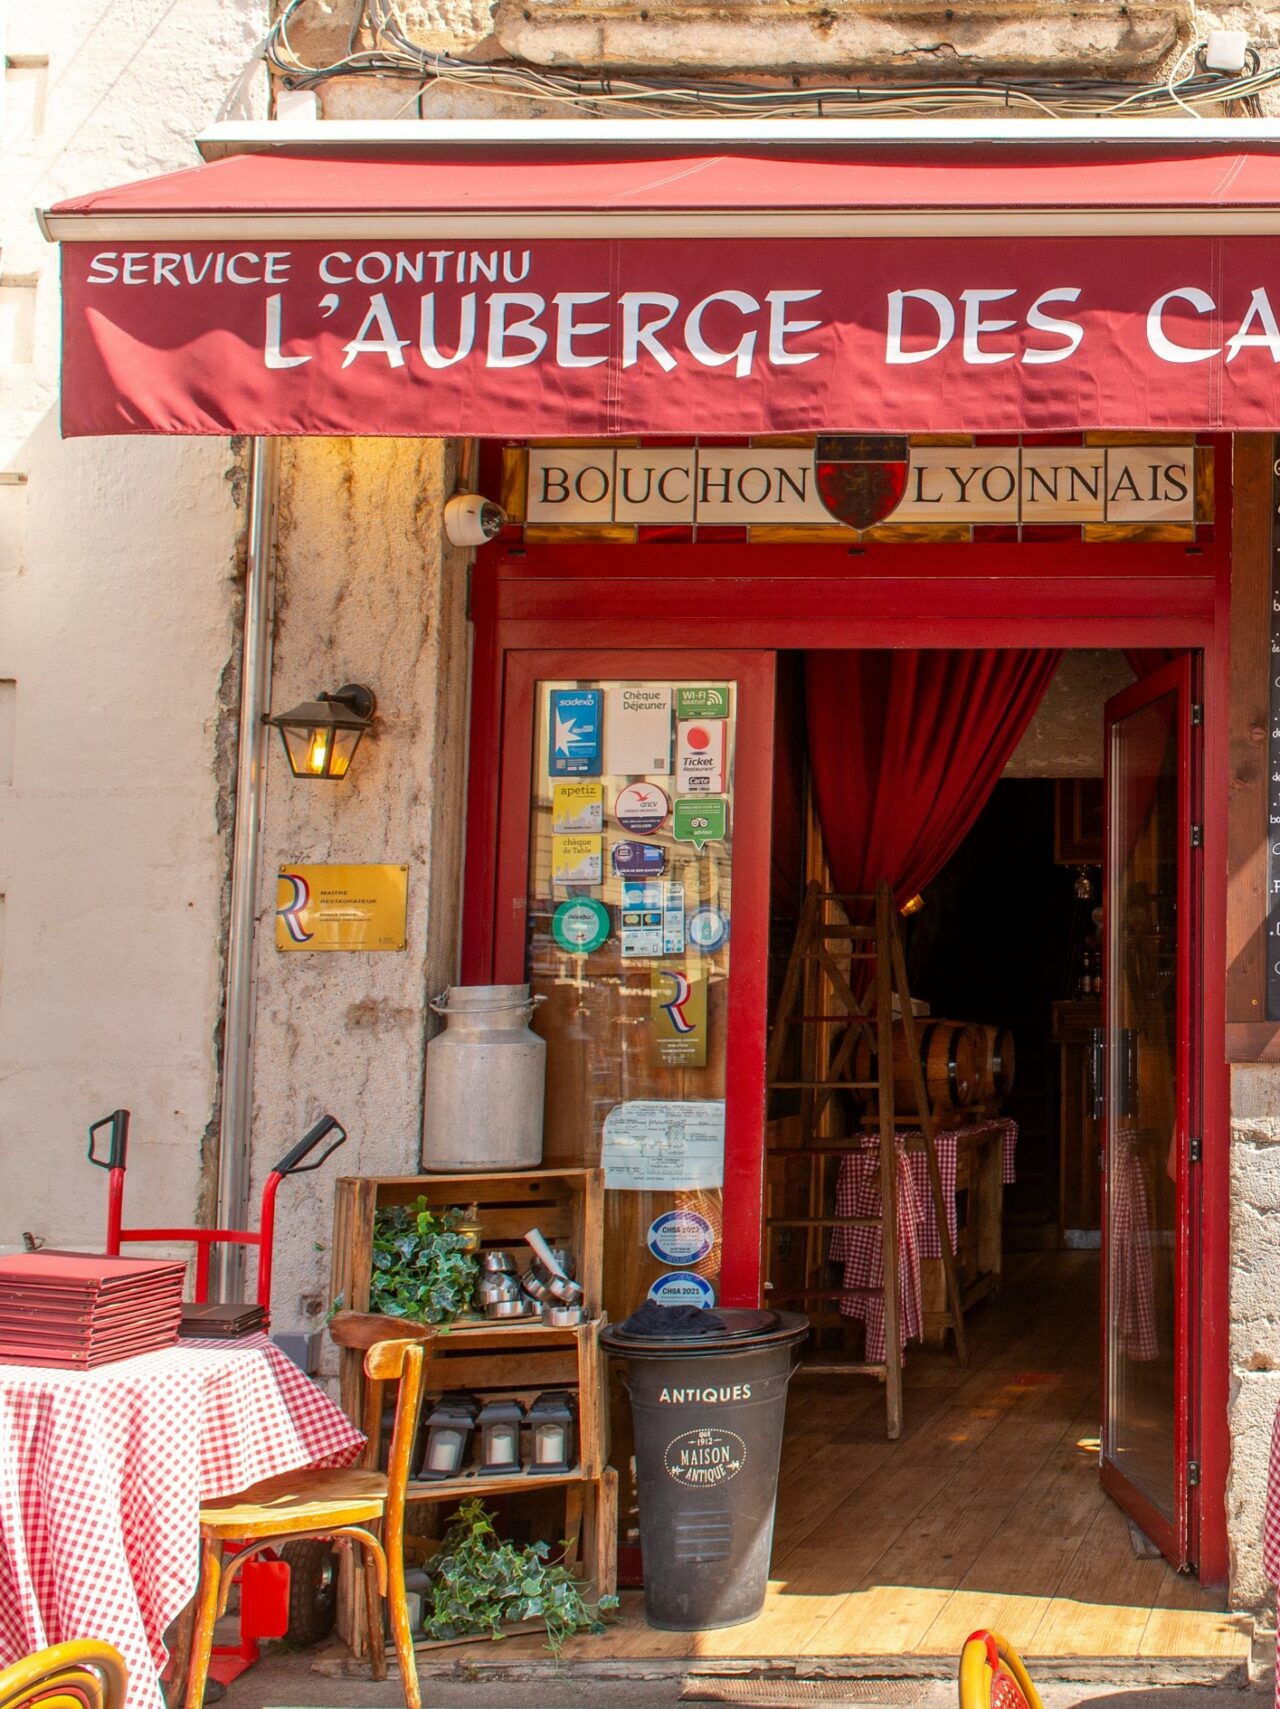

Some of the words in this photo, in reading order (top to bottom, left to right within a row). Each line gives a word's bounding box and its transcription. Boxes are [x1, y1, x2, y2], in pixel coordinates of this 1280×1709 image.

[86, 251, 292, 285] SERVICE
[318, 250, 530, 284] CONTINU
[263, 289, 823, 378] L'AUBERGE
[885, 287, 1083, 364] DES
[539, 467, 807, 504] BOUCHON
[913, 465, 1188, 504] LYONNAIS
[623, 690, 660, 701] Chèque
[559, 697, 594, 706] sodexo
[623, 701, 667, 711] Déjeuner
[683, 757, 714, 766] Ticket
[560, 786, 596, 797] apetiz
[563, 838, 592, 848] chèque
[662, 1287, 680, 1295] CHSA
[659, 1384, 751, 1404] ANTIQUES
[697, 1437, 713, 1446] 1912
[681, 1446, 730, 1466] MAISON
[685, 1463, 727, 1483] ANTIQUE
